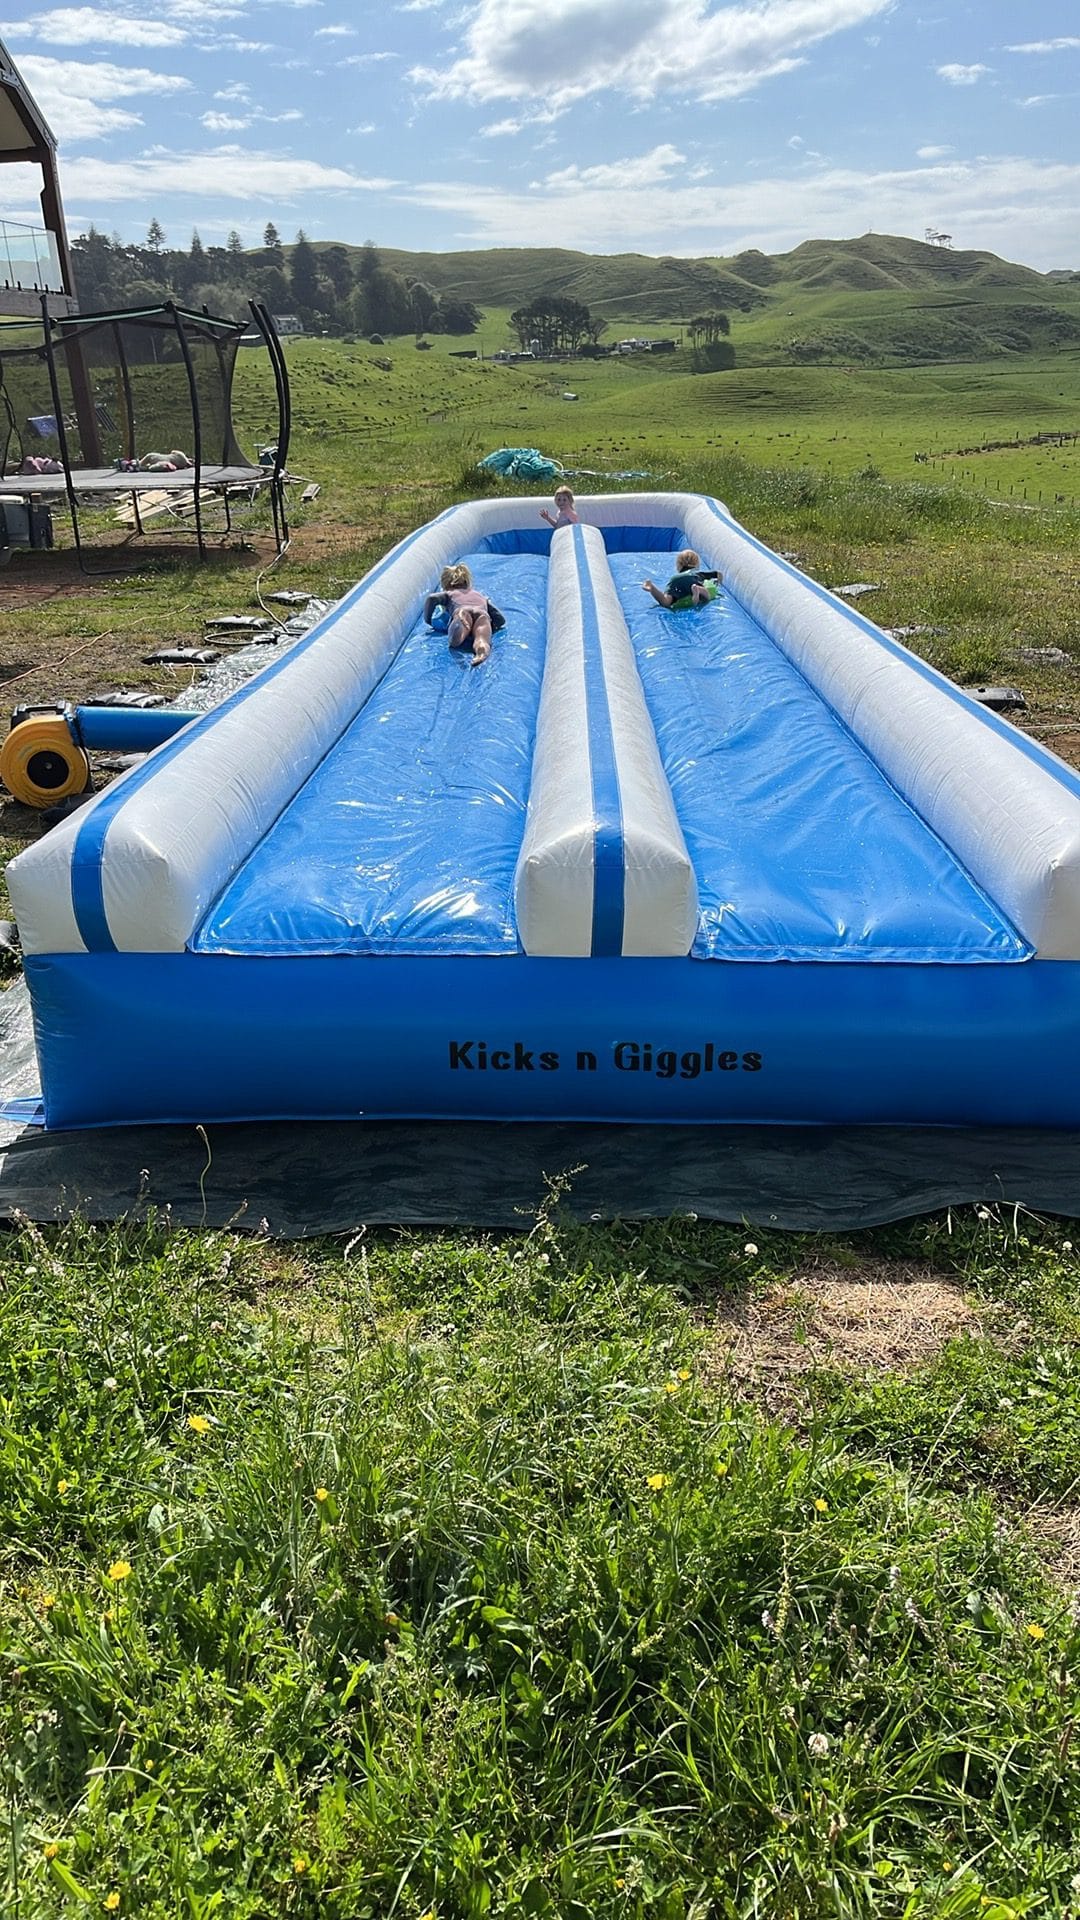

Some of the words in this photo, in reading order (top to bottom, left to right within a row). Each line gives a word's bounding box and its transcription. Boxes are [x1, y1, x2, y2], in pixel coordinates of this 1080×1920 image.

[449, 1041, 560, 1071] Kicks
[576, 1051, 597, 1071] n
[614, 1042, 763, 1079] Giggles
